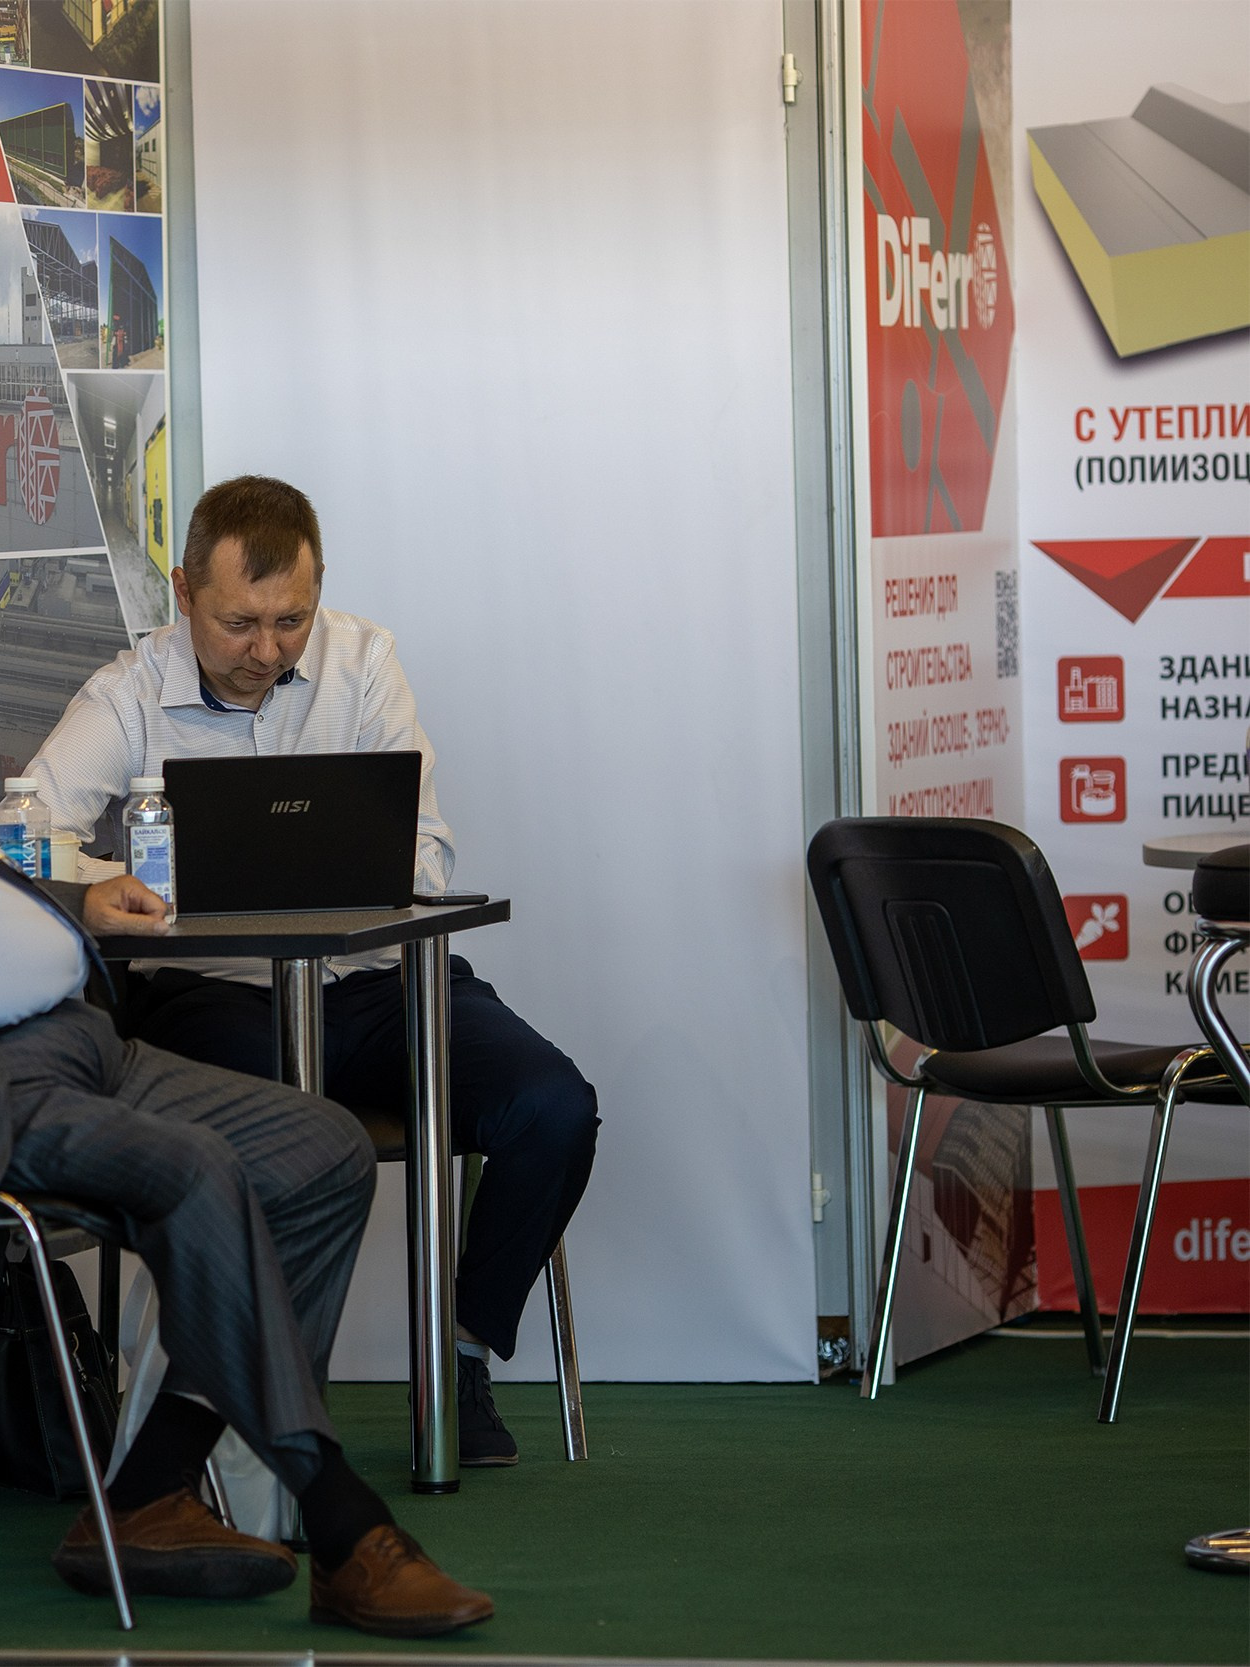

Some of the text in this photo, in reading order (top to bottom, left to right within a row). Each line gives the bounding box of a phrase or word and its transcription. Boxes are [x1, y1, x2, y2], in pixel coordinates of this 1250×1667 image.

[1075, 403, 1250, 442] С УТЕПЛИ
[1076, 453, 1250, 491] (ПОЛИИЗОЦ
[886, 574, 957, 621] РЕШЕНИЯ ДЛЯ
[887, 643, 972, 690] СТРОИТЕЛЬСТВА
[1161, 695, 1250, 720] НАЗН
[888, 708, 930, 768] ЗДАНИЙ
[976, 706, 1009, 748] ЗЕРНО-
[1162, 753, 1250, 781] ПРЕД
[270, 800, 311, 814] MSI
[1166, 971, 1249, 994] КМЕ
[1173, 1217, 1250, 1262] dife
